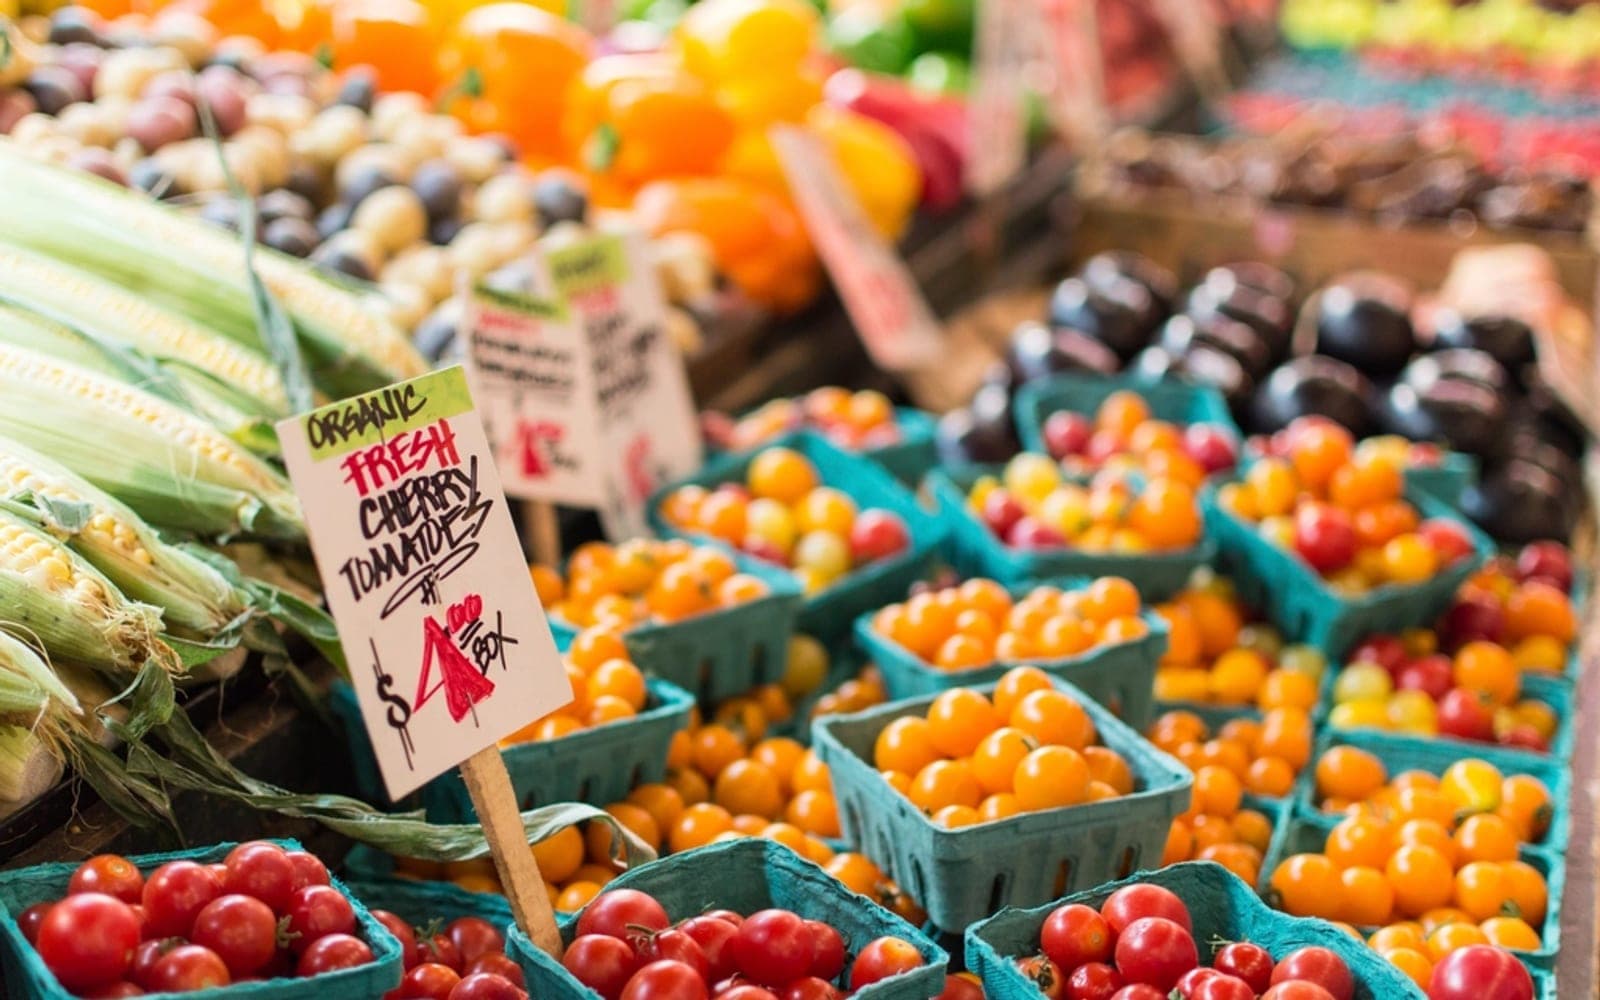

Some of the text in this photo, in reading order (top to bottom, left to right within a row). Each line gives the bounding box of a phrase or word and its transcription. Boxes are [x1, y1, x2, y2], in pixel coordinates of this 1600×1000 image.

[307, 384, 427, 449] ORGANIC
[340, 418, 460, 497] FRESH
[359, 455, 480, 540] CHERRY
[338, 500, 494, 601] TOMATOES
[472, 609, 518, 677] BOX
